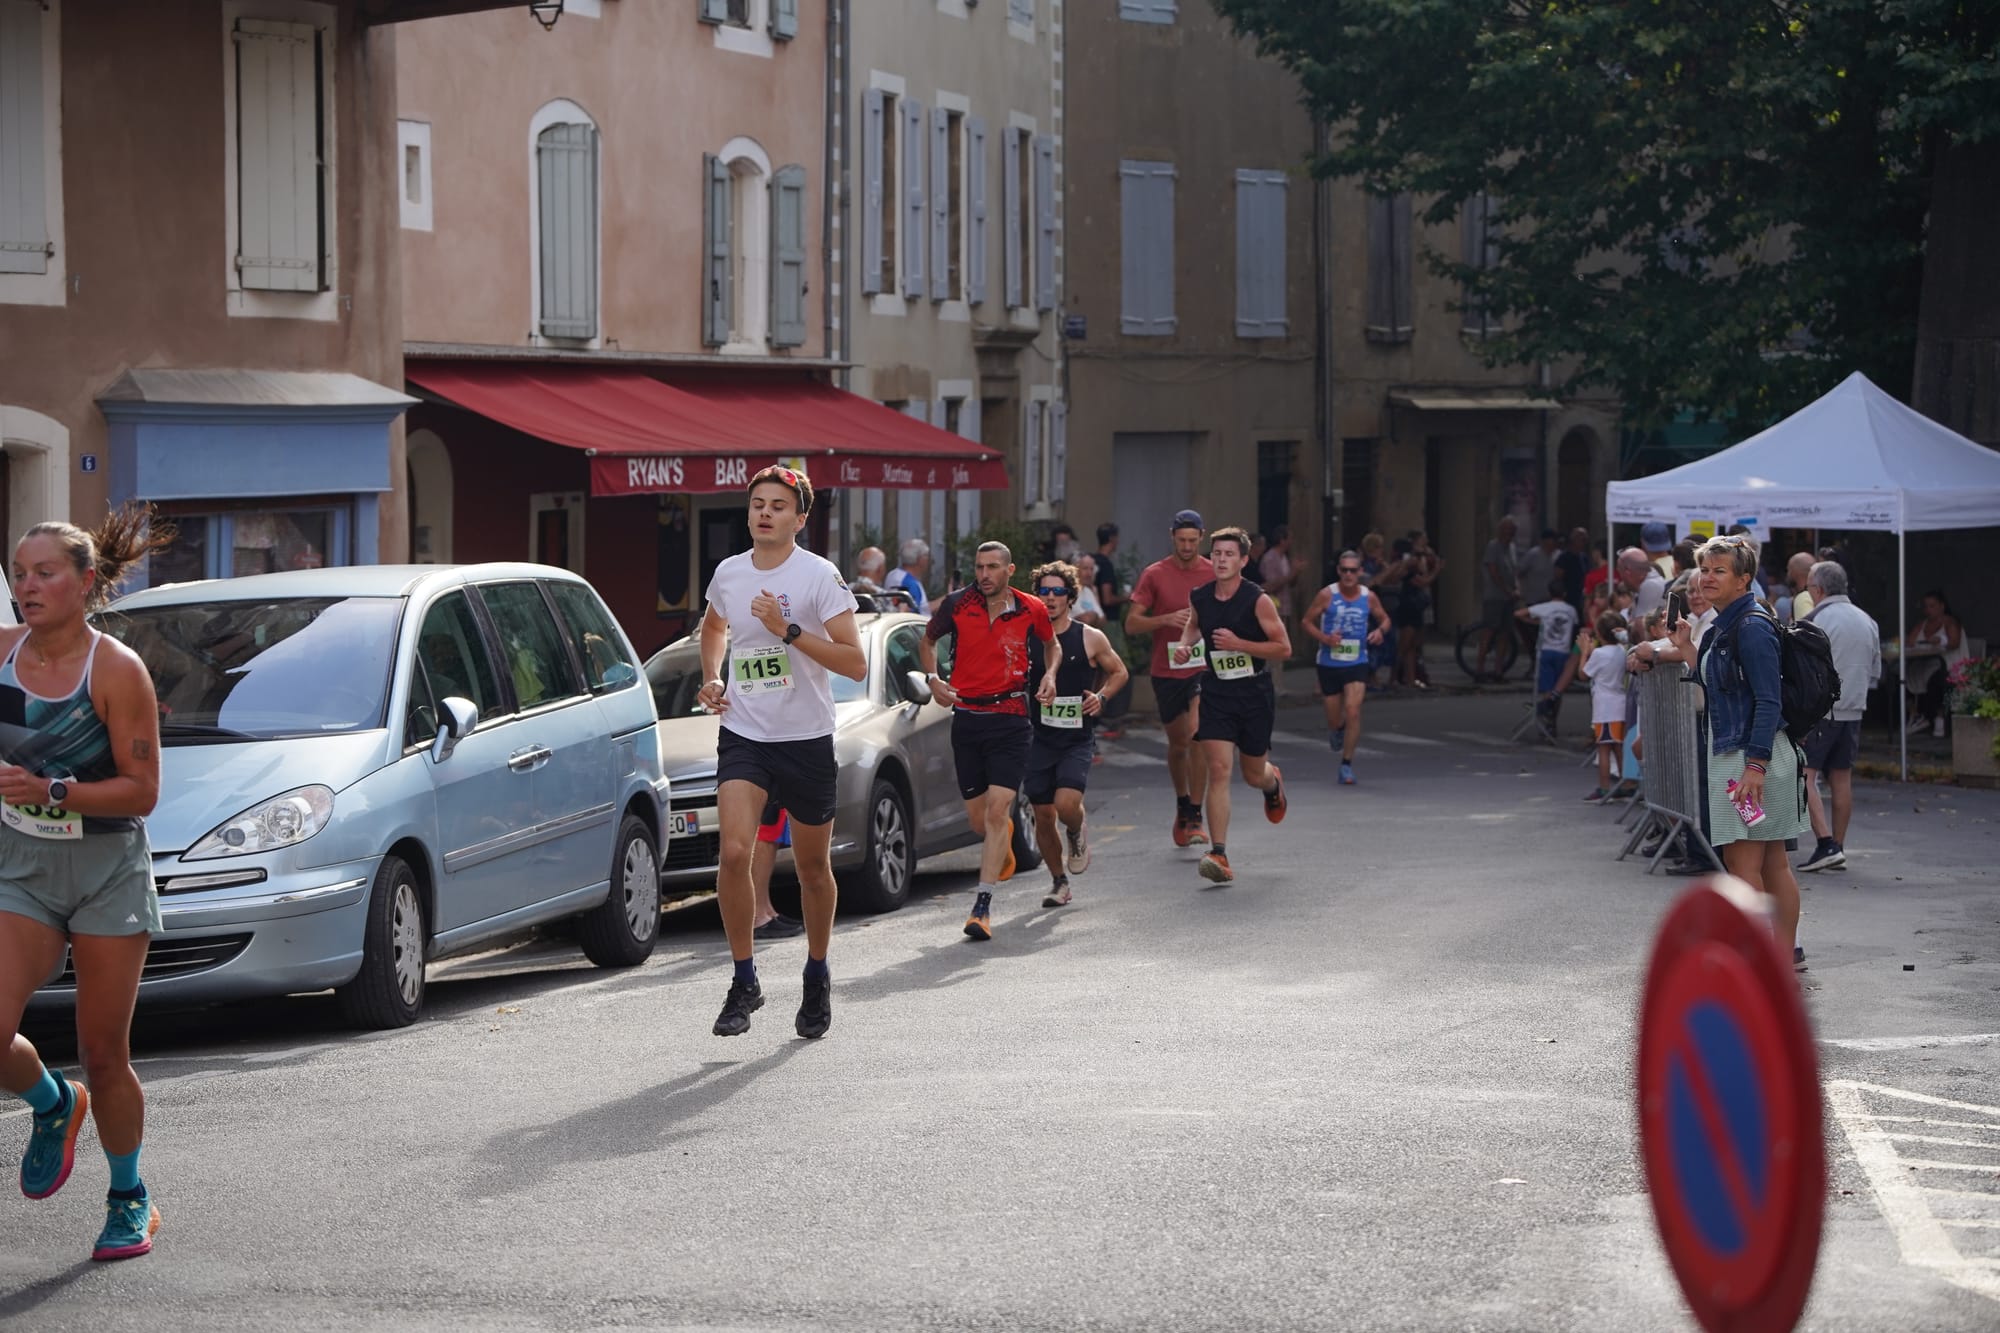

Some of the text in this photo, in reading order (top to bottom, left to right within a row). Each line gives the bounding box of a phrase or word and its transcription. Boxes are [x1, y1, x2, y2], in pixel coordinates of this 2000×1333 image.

[86, 457, 92, 470] 6
[628, 458, 748, 487] RYAN'S BAR
[841, 459, 861, 483] Chez
[928, 469, 936, 484] et
[741, 658, 781, 679] 115
[1217, 655, 1246, 671] 186
[1046, 705, 1076, 718] 175
